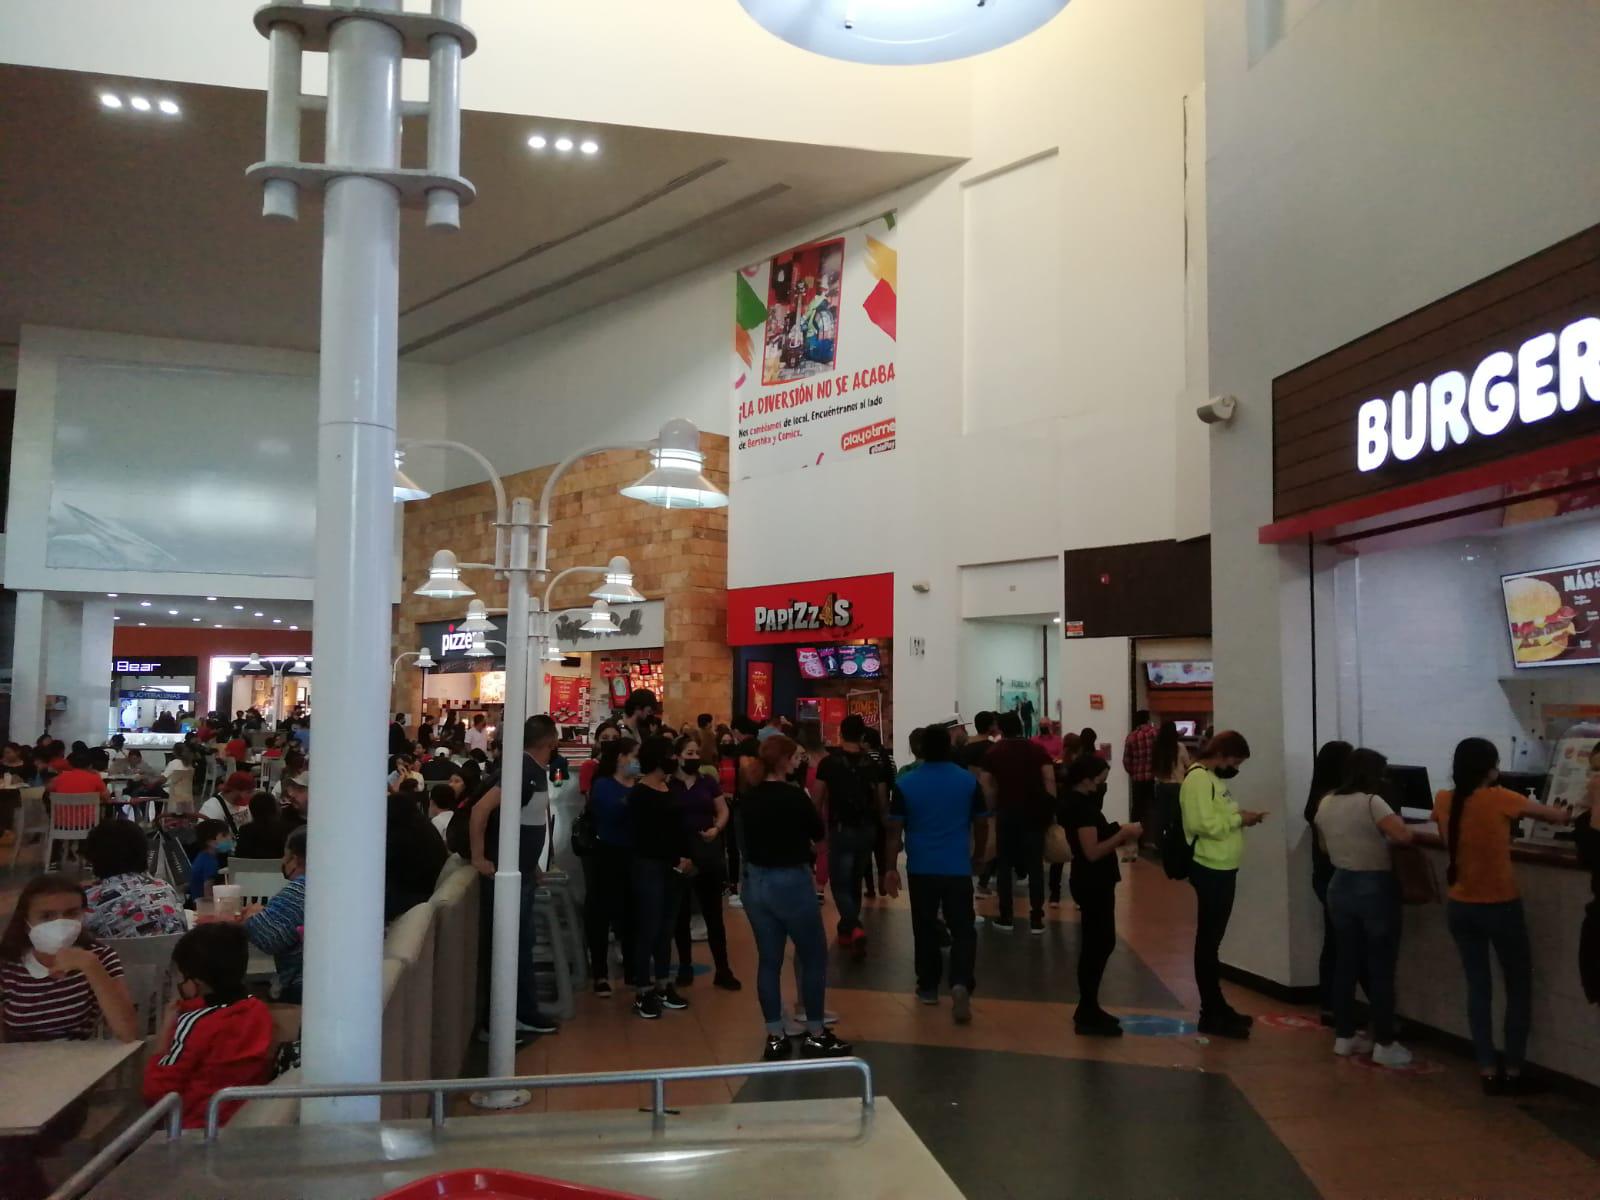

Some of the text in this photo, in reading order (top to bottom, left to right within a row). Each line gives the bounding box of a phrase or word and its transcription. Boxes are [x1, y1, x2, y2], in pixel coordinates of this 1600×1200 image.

[738, 362, 896, 425] ¡LA DIVERSIÓN NO SE ACABA
[1357, 316, 1600, 473] BURGER
[738, 428, 749, 438] Nos
[783, 418, 792, 427] de
[811, 402, 858, 420] Encuéntranos
[860, 399, 866, 409] al
[867, 395, 883, 408] lado
[738, 442, 746, 450] de
[747, 436, 772, 448] Bershka
[1562, 569, 1594, 592] MÁS
[441, 624, 484, 657] pizze
[116, 660, 162, 672] Bear
